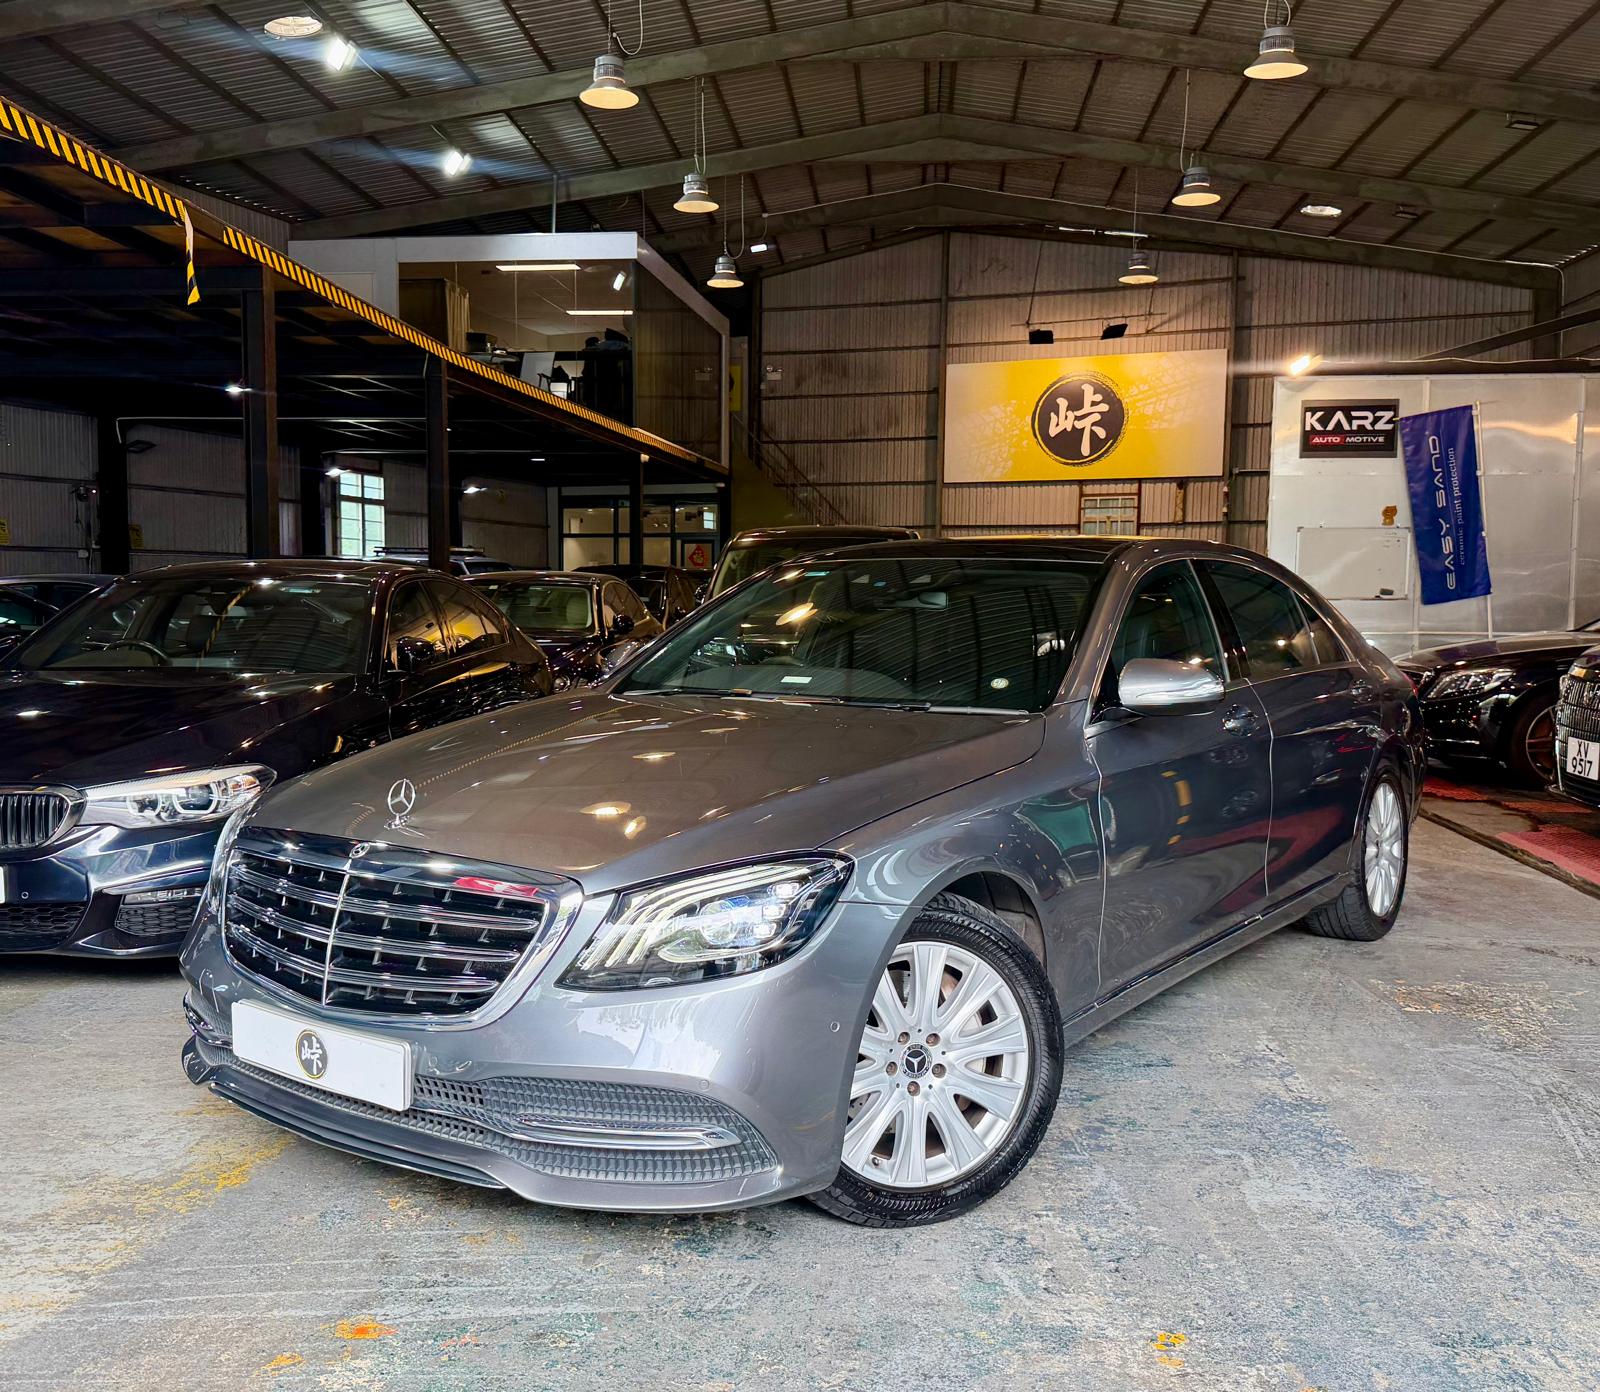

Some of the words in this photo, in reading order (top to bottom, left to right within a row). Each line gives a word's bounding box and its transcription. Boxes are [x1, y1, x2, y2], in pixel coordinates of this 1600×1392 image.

[1049, 383, 1110, 457] 峠
[1304, 410, 1395, 431] KARZ
[1428, 435, 1446, 508] SAND
[1448, 447, 1462, 497] protection
[1453, 500, 1465, 525] paint
[1438, 518, 1456, 590] EASY
[1457, 527, 1465, 566] ceramic
[1571, 757, 1593, 777] 9517
[1576, 740, 1590, 759] XV
[301, 1035, 323, 1076] 峠
